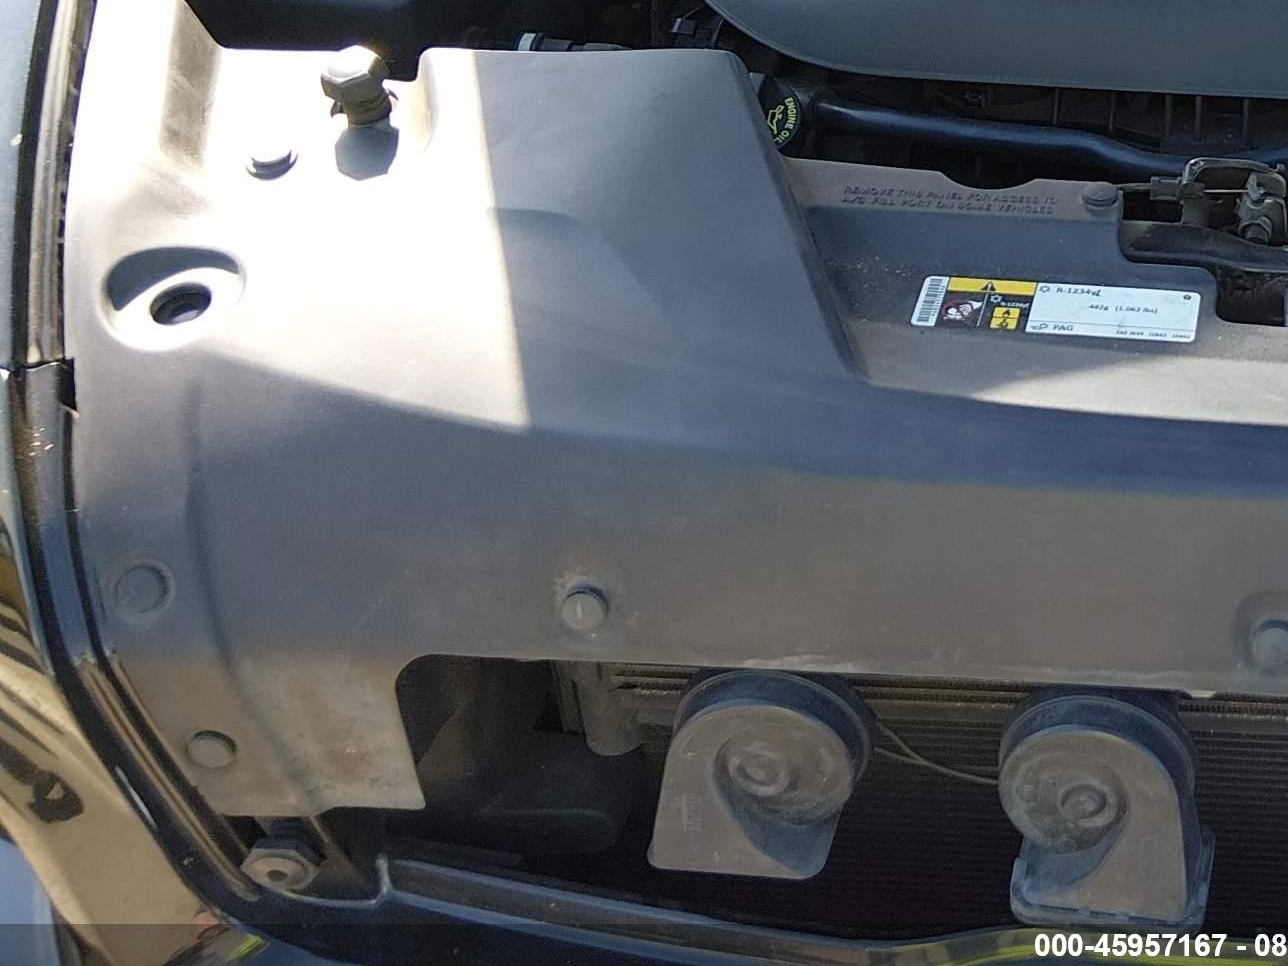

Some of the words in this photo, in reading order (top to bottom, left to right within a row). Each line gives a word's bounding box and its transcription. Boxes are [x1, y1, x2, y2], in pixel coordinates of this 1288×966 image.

[784, 97, 797, 129] ENGINE
[774, 130, 790, 143] OIL
[844, 185, 896, 197] REMOVE
[897, 188, 923, 199] THIS
[927, 191, 963, 201] PANEL
[968, 192, 989, 202] FOR
[993, 194, 1039, 204] ACCESS
[958, 201, 993, 211] SOME
[998, 203, 1054, 215] VEHICLES
[1056, 286, 1102, 298] R-1234yf
[1053, 323, 1075, 332] PAG
